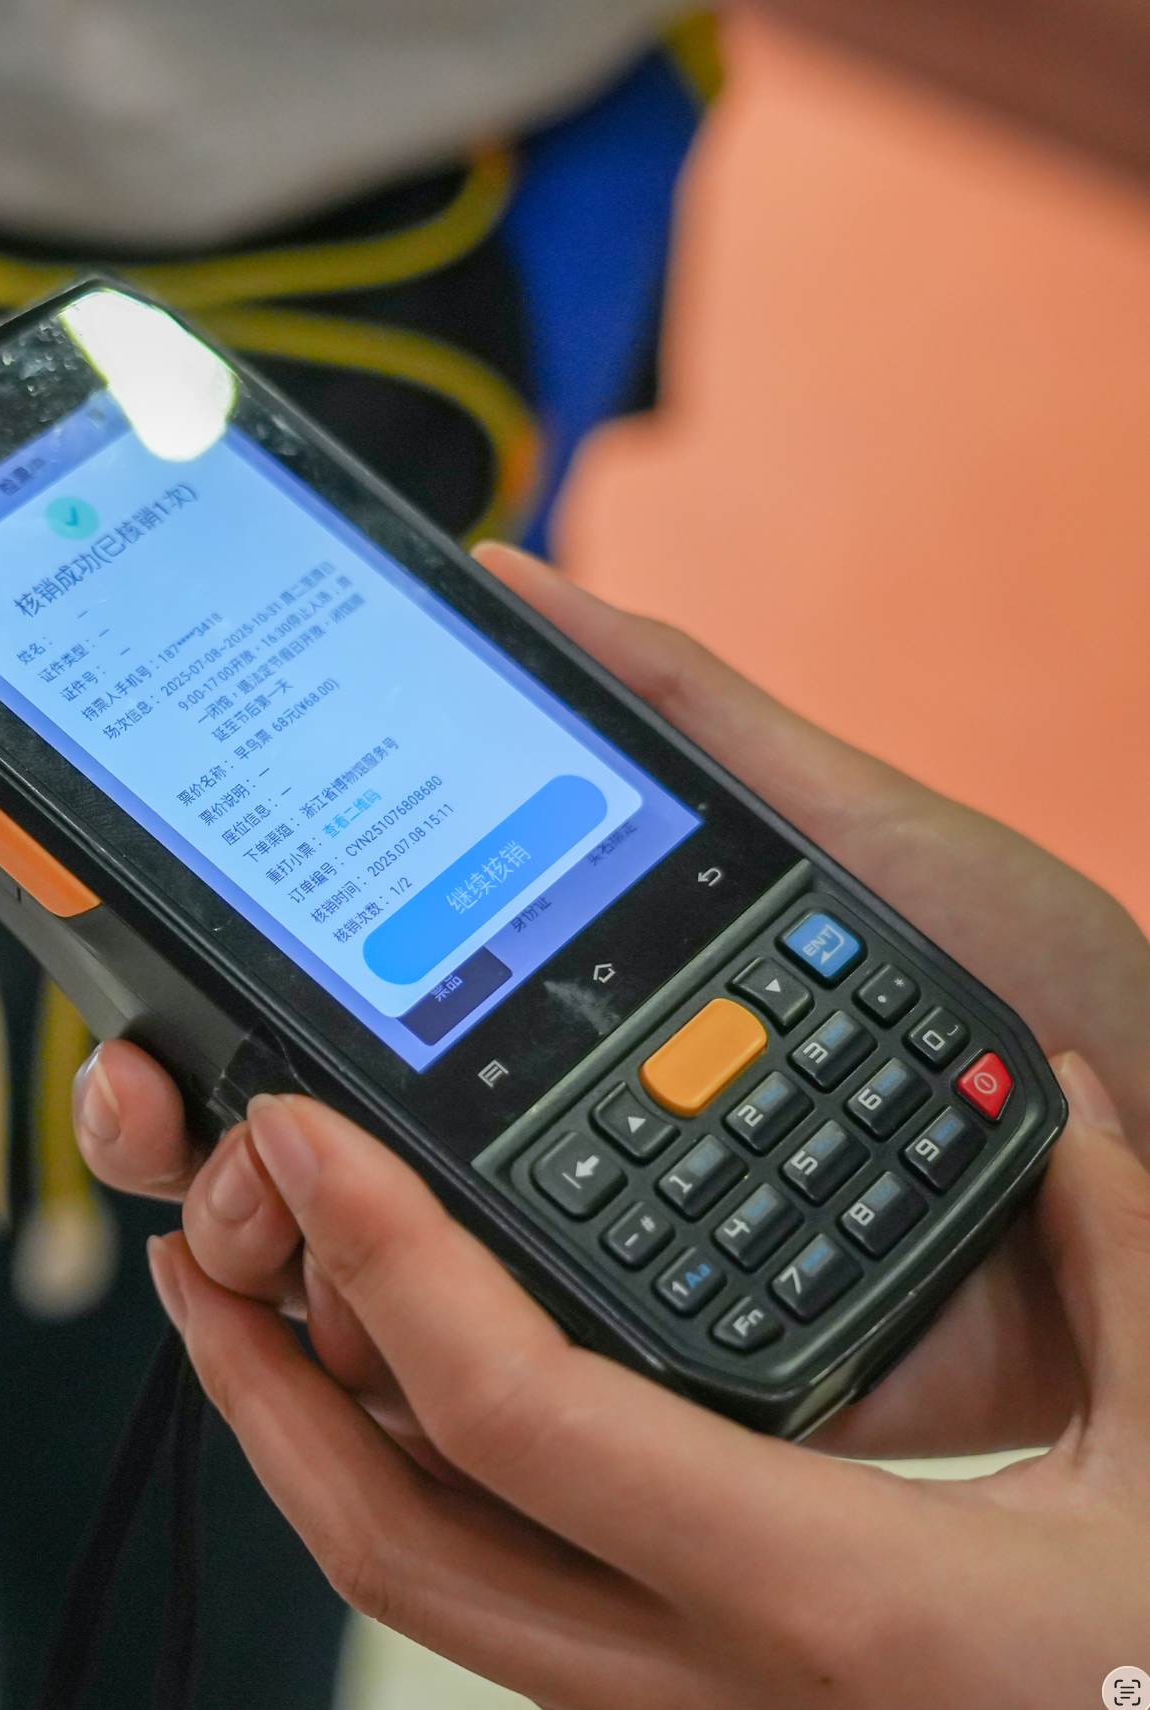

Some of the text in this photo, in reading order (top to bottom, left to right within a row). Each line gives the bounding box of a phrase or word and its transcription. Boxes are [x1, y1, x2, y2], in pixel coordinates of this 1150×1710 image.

[213, 679, 291, 742] 延至节后第一天
[235, 731, 271, 761] 早鸟票
[300, 738, 398, 817] 浙江省博物馆服务号
[322, 789, 380, 838] 查看二维码
[346, 777, 441, 856] CYN251076808680
[368, 828, 425, 876] 2025.07.08
[424, 804, 453, 829] 15:11
[391, 878, 410, 895] 1/2
[445, 840, 530, 915] 继续核销
[802, 928, 833, 957] ENT
[803, 1042, 828, 1064] 3
[922, 1030, 945, 1051] 0
[857, 1088, 882, 1110] 6
[737, 1104, 764, 1127] 2
[791, 1150, 818, 1175] 5
[915, 1138, 940, 1162] 9
[669, 1174, 693, 1194] 1
[850, 1202, 875, 1226] 8
[723, 1218, 750, 1238] 4
[779, 1266, 801, 1294] 7
[732, 1308, 764, 1336] Fn
